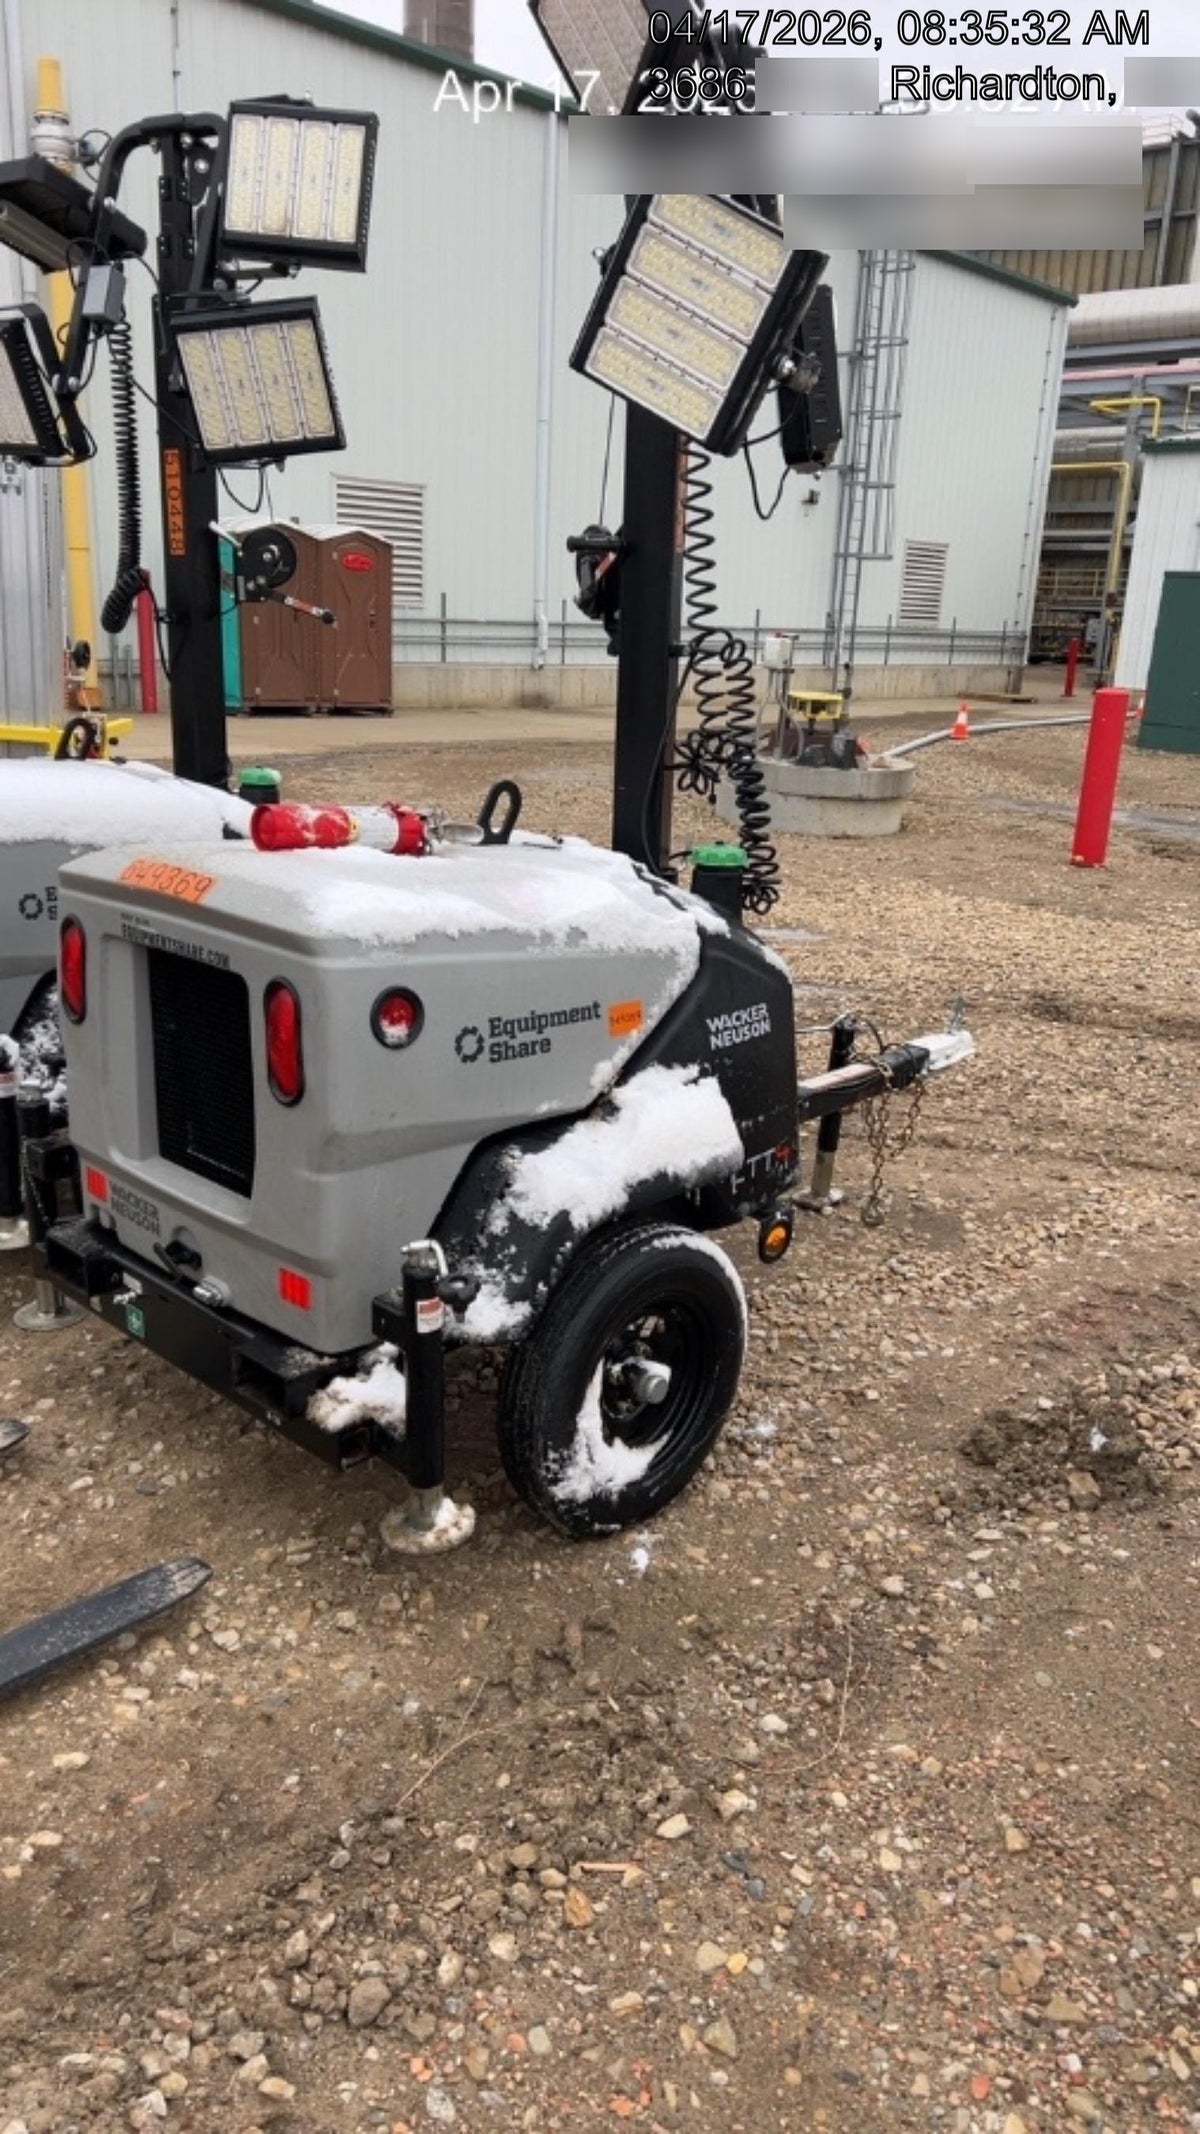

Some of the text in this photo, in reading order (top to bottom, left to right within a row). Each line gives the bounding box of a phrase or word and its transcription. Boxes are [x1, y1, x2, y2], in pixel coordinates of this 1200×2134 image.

[488, 1001, 601, 1039] Equipment
[706, 1002, 769, 1033] WACKER
[488, 1038, 552, 1063] Share
[710, 1018, 772, 1051] NEUSON
